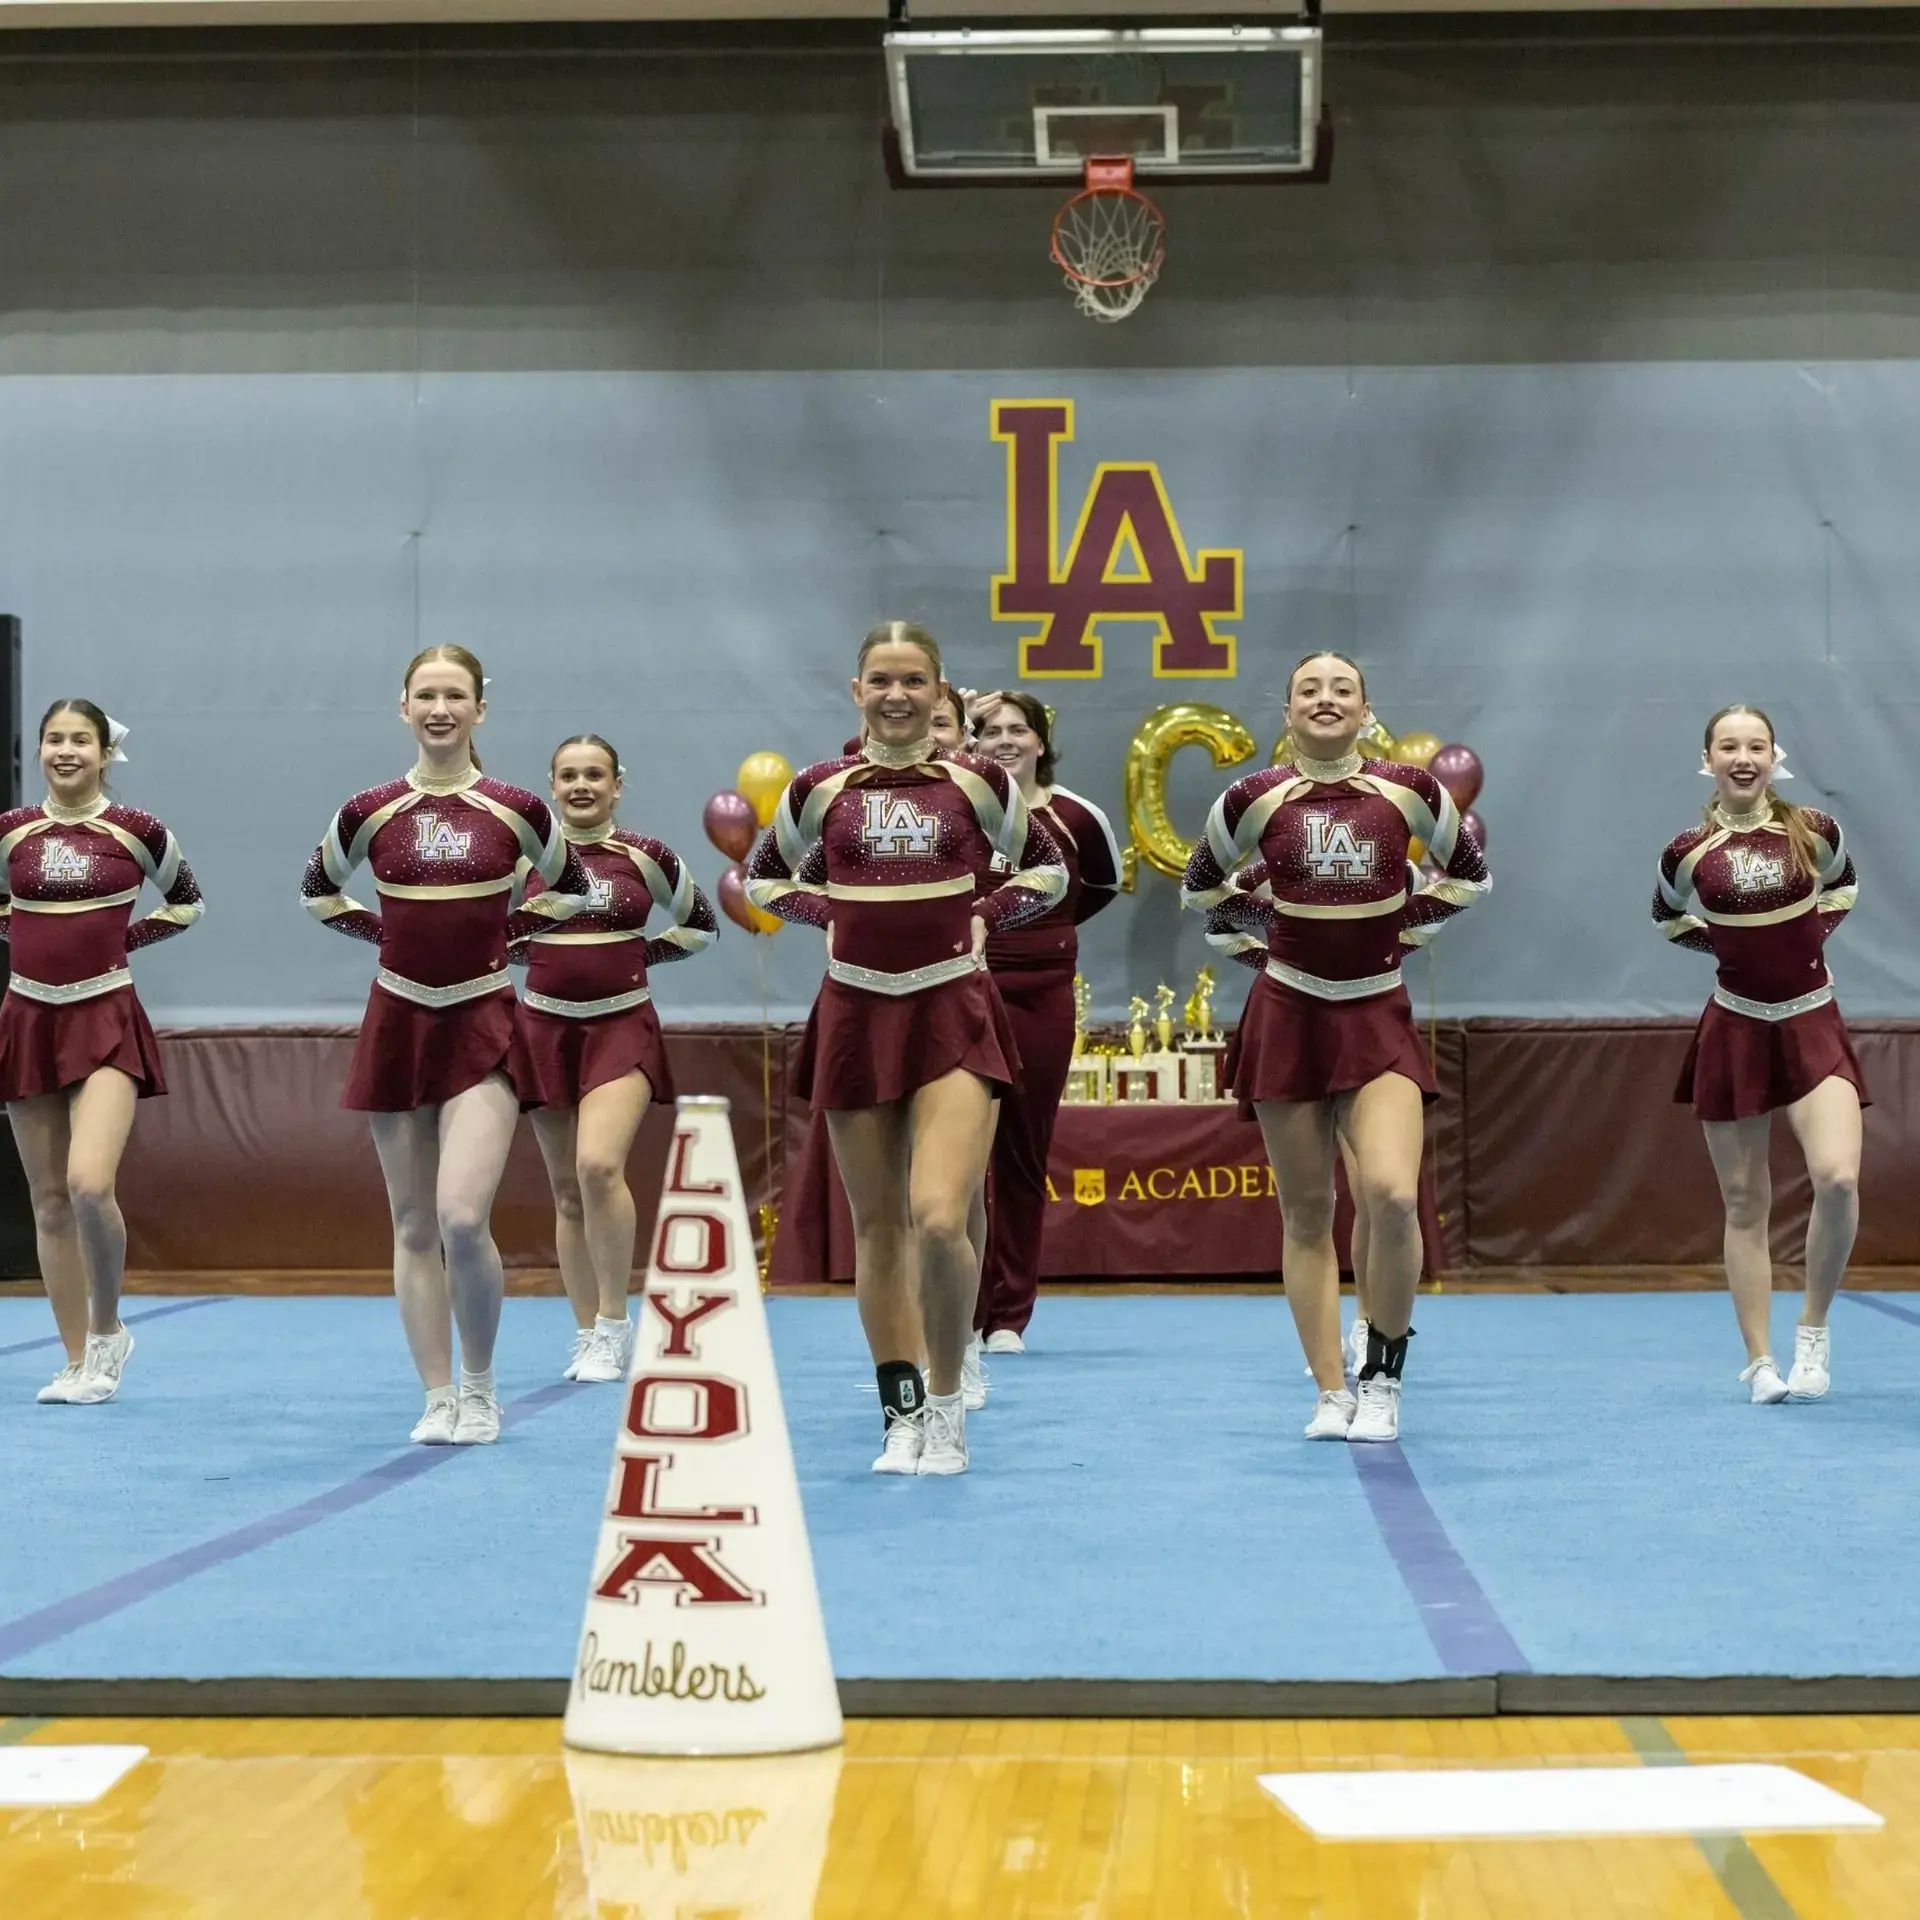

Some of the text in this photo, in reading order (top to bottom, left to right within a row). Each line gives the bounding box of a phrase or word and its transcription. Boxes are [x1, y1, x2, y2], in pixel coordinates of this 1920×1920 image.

[990, 398, 1244, 678] LA
[416, 814, 470, 860] LA
[862, 792, 938, 856] LA
[1303, 814, 1375, 879] LA
[41, 837, 90, 880] LA
[1727, 848, 1783, 891] LA
[595, 1128, 767, 1608] LOYOLA
